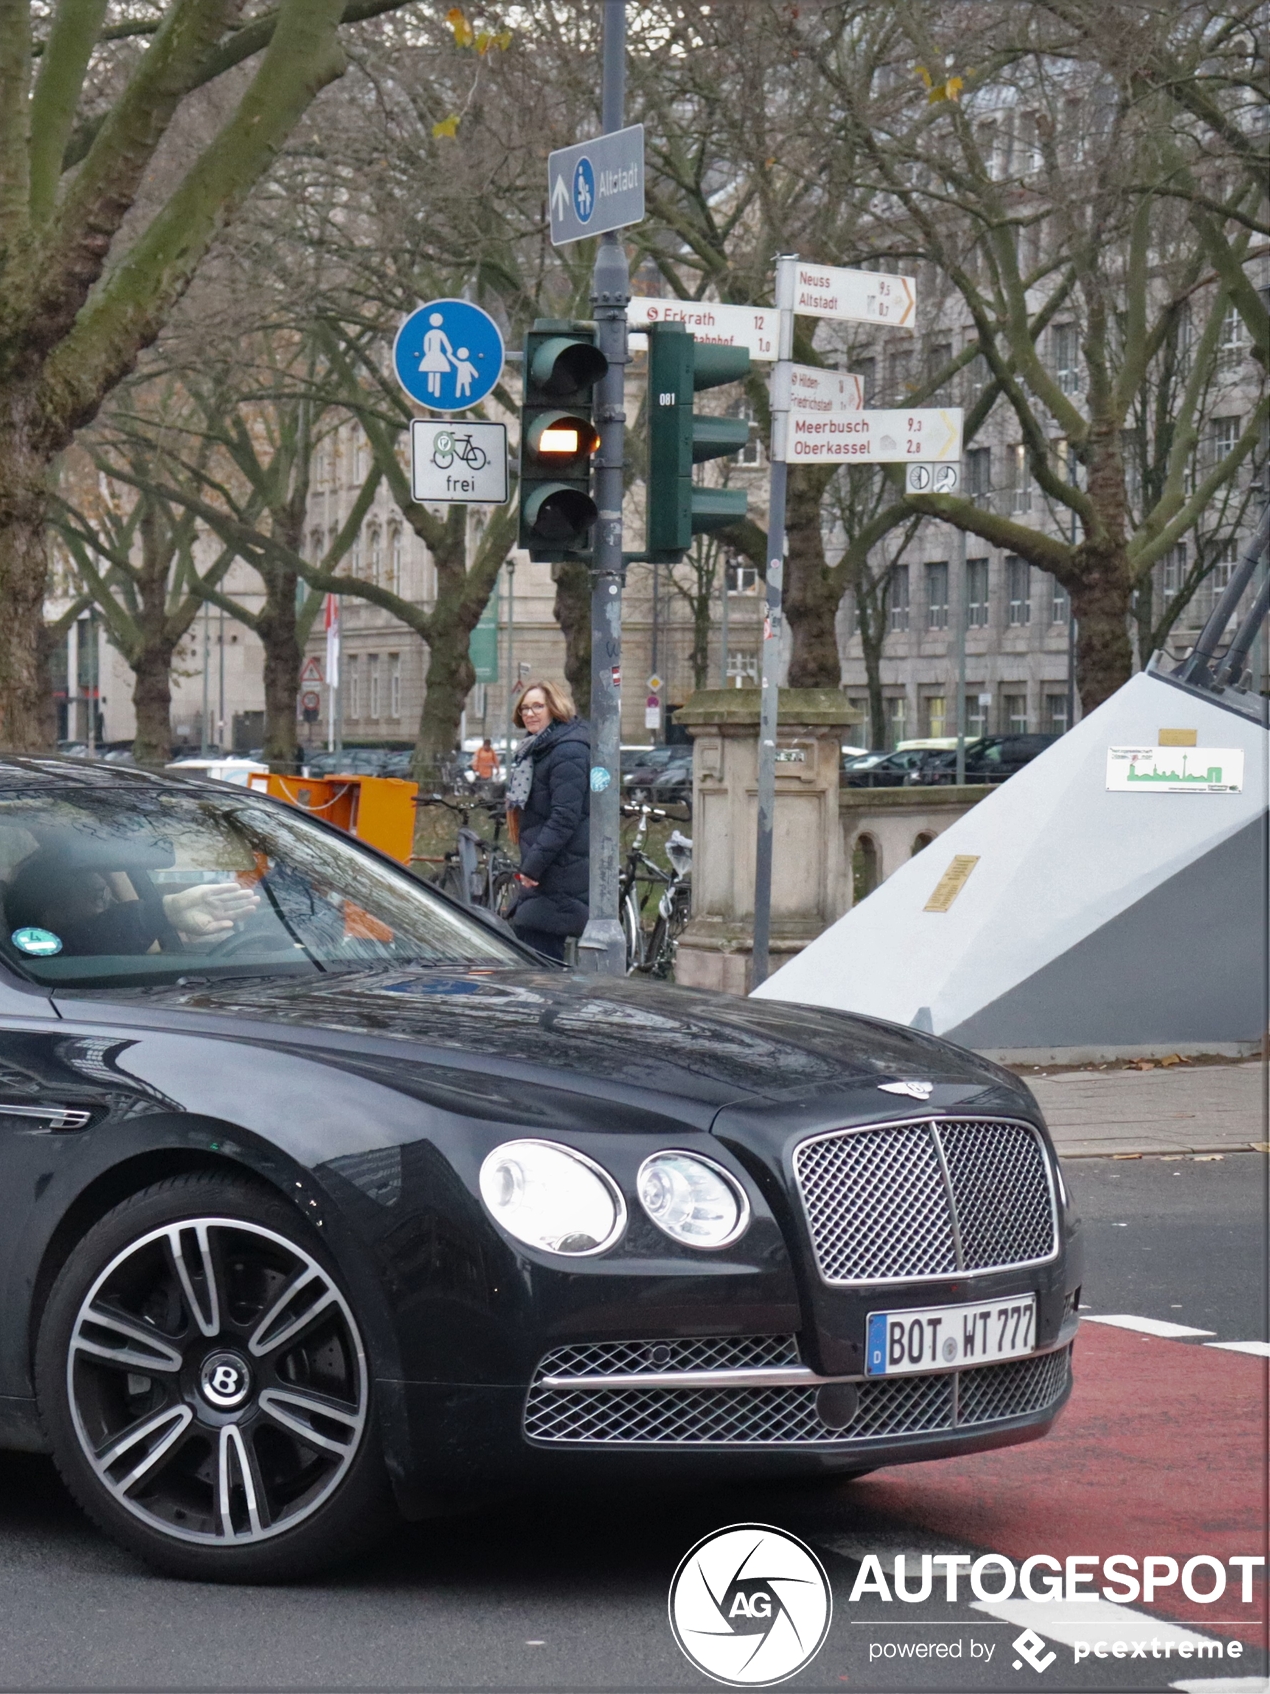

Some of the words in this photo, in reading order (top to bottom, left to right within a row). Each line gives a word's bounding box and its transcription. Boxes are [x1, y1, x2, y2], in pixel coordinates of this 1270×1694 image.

[599, 162, 639, 198] Altstadt
[799, 271, 831, 288] Neuss
[799, 292, 838, 311] Altstadt
[664, 308, 716, 327] Erkrath
[754, 316, 765, 330] 12
[659, 393, 675, 406] 081
[795, 419, 870, 434] Meerbusch
[794, 441, 871, 455] Oberkassel
[447, 475, 475, 492] frei
[30, 932, 42, 942] 4
[888, 1318, 942, 1366] BOT
[963, 1311, 992, 1358] WT
[997, 1303, 1034, 1352] 777
[873, 1351, 882, 1364] D
